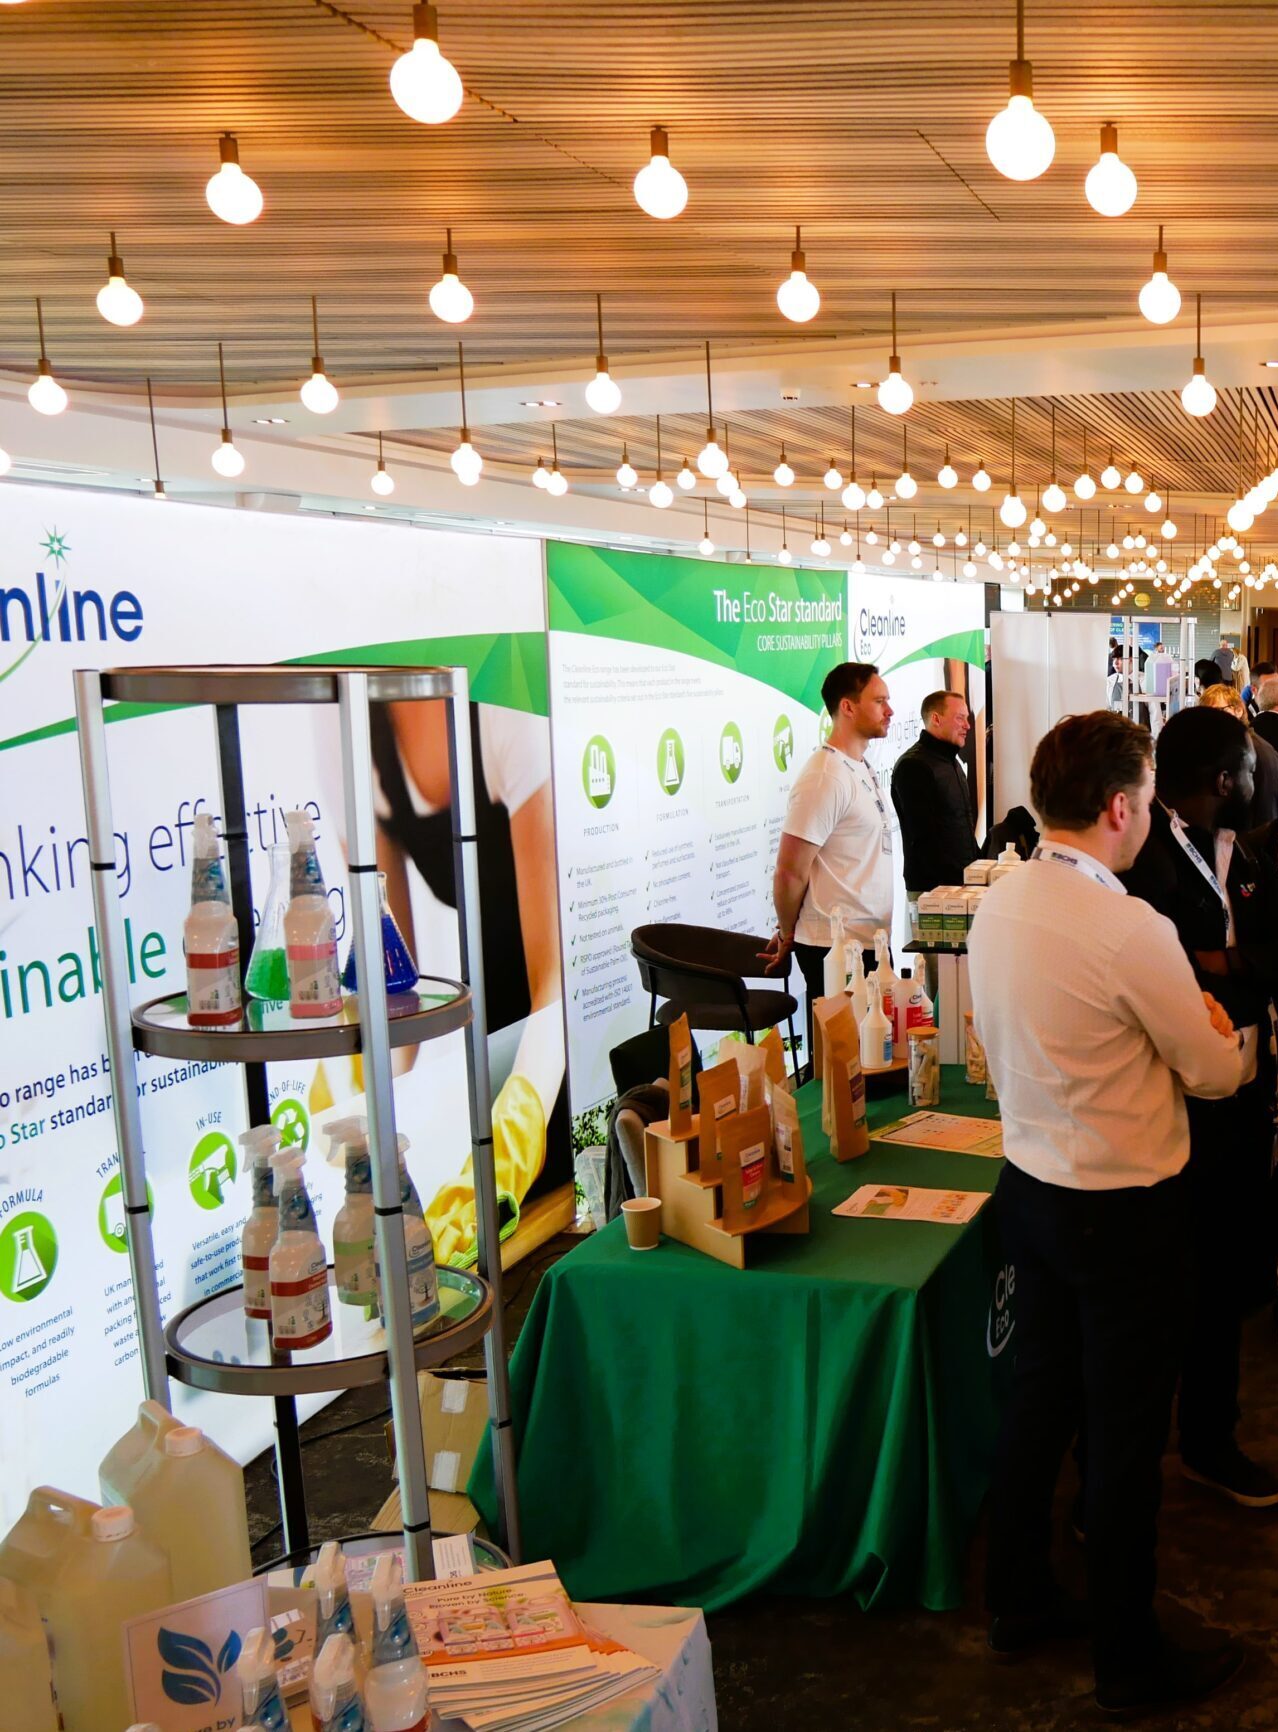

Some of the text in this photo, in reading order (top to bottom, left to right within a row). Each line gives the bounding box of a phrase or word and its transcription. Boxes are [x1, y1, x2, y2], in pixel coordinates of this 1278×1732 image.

[713, 589, 842, 623] The Eco Star standard
[860, 607, 906, 637] Cleanline
[757, 632, 842, 652] CORE SUSTAINABILITY PILLARS
[860, 639, 872, 656] Eco
[149, 794, 321, 872] efftive
[15, 1072, 66, 1104] range
[69, 1061, 98, 1085] has
[10, 1117, 46, 1145] Star
[50, 1094, 113, 1131] standar
[151, 1061, 239, 1094] sustainab
[195, 1111, 222, 1132] IN-USE
[190, 1244, 225, 1270] safe-to-use
[195, 1255, 238, 1286] that work first
[204, 1269, 243, 1297] in commercia
[104, 1283, 115, 1298] UK
[107, 1300, 123, 1315] with
[16, 1306, 73, 1343] environmental
[104, 1313, 133, 1337] packing
[32, 1340, 48, 1356] and
[49, 1325, 76, 1344] readily
[113, 1334, 134, 1350] waste
[11, 1348, 69, 1387] biodegradable
[114, 1346, 139, 1368] carbon
[24, 1373, 61, 1399] formulas
[403, 1580, 473, 1594] Cleanline
